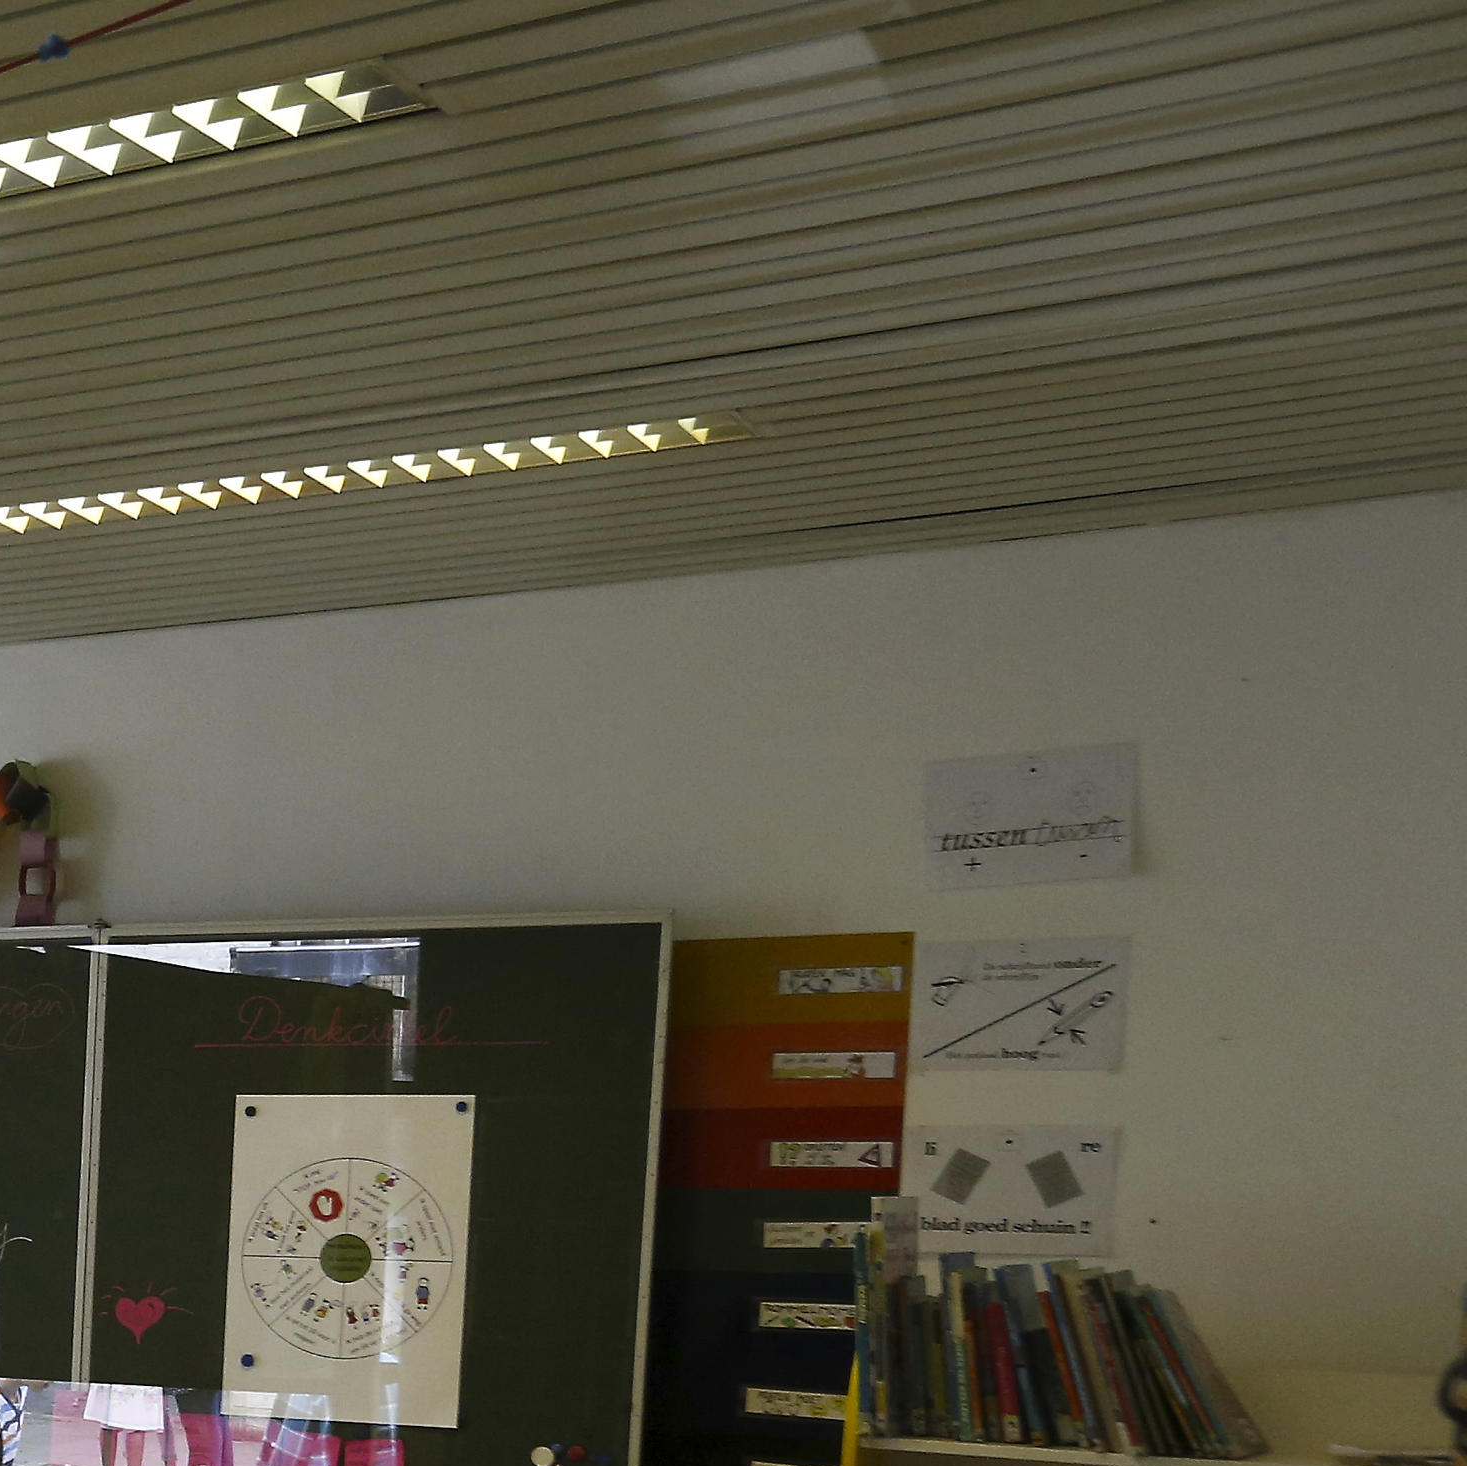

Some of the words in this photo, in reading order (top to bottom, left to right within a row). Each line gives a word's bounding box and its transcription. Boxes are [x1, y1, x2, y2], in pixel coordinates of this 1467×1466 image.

[237, 995, 458, 1046] Denkcirel
[1080, 1142, 1102, 1153] re
[920, 1216, 961, 1231] blad
[963, 1217, 1009, 1235] goed
[1013, 1218, 1077, 1235] schuin
